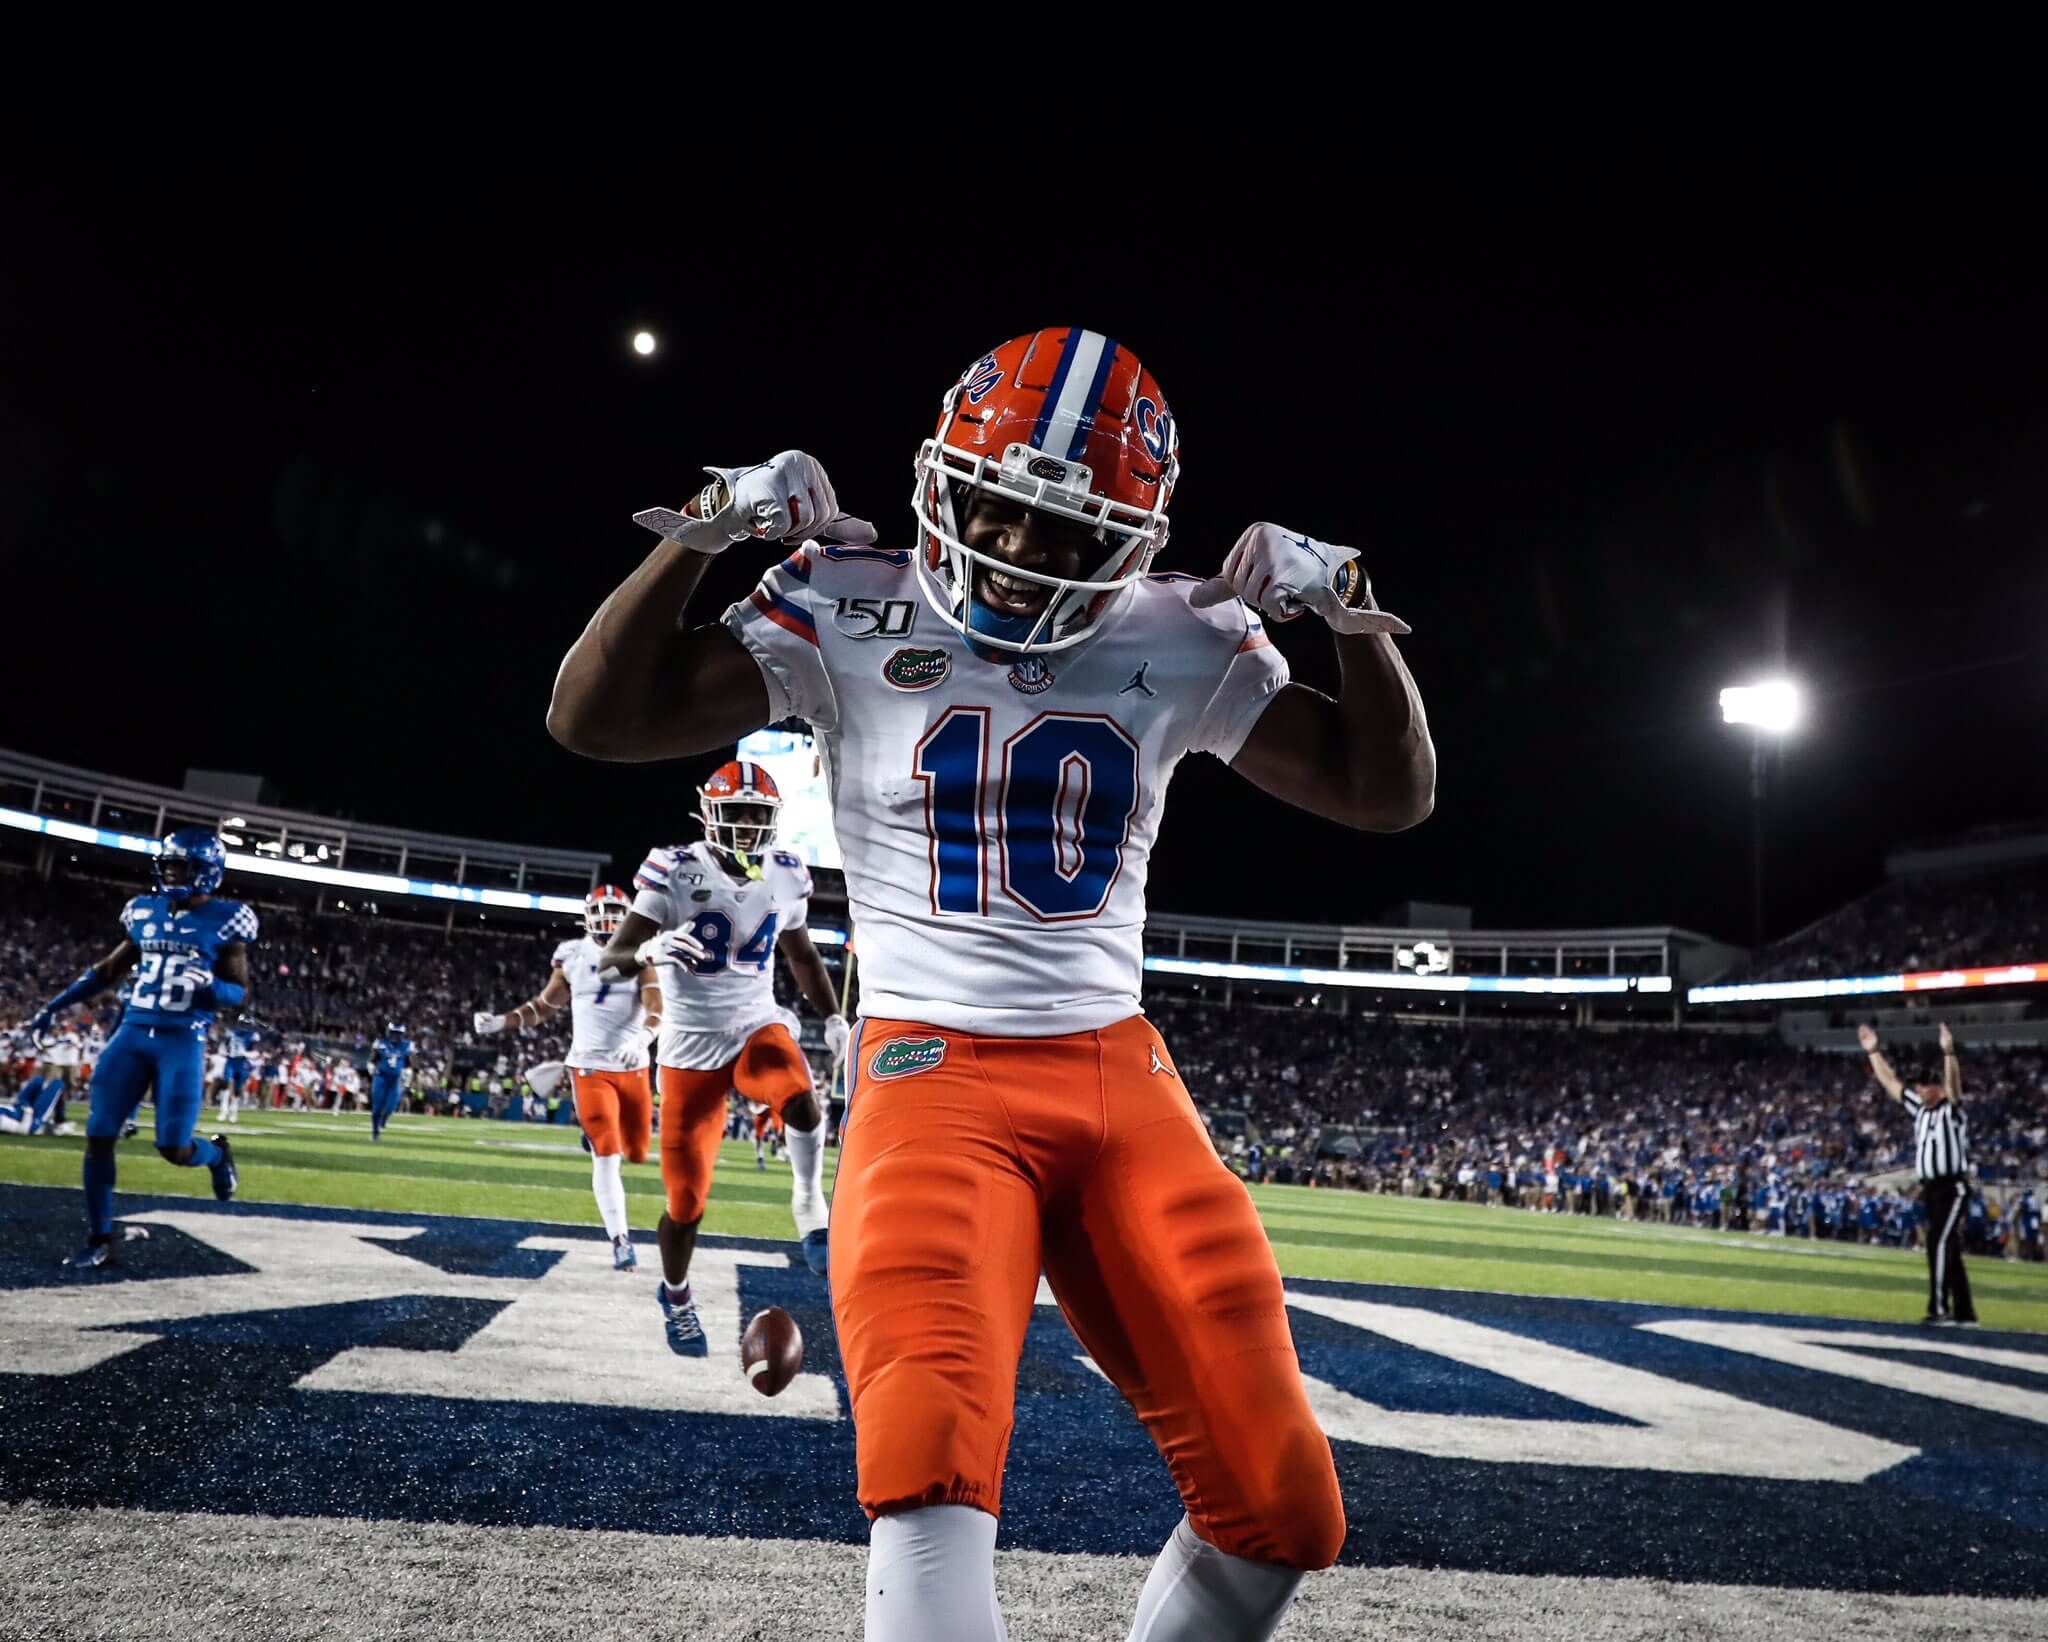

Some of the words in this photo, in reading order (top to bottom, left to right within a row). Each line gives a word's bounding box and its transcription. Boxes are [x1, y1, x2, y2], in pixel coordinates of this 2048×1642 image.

[833, 597, 915, 636] 150
[912, 705, 1140, 922] 10
[686, 908, 780, 976] 84
[130, 952, 196, 1012] 26
